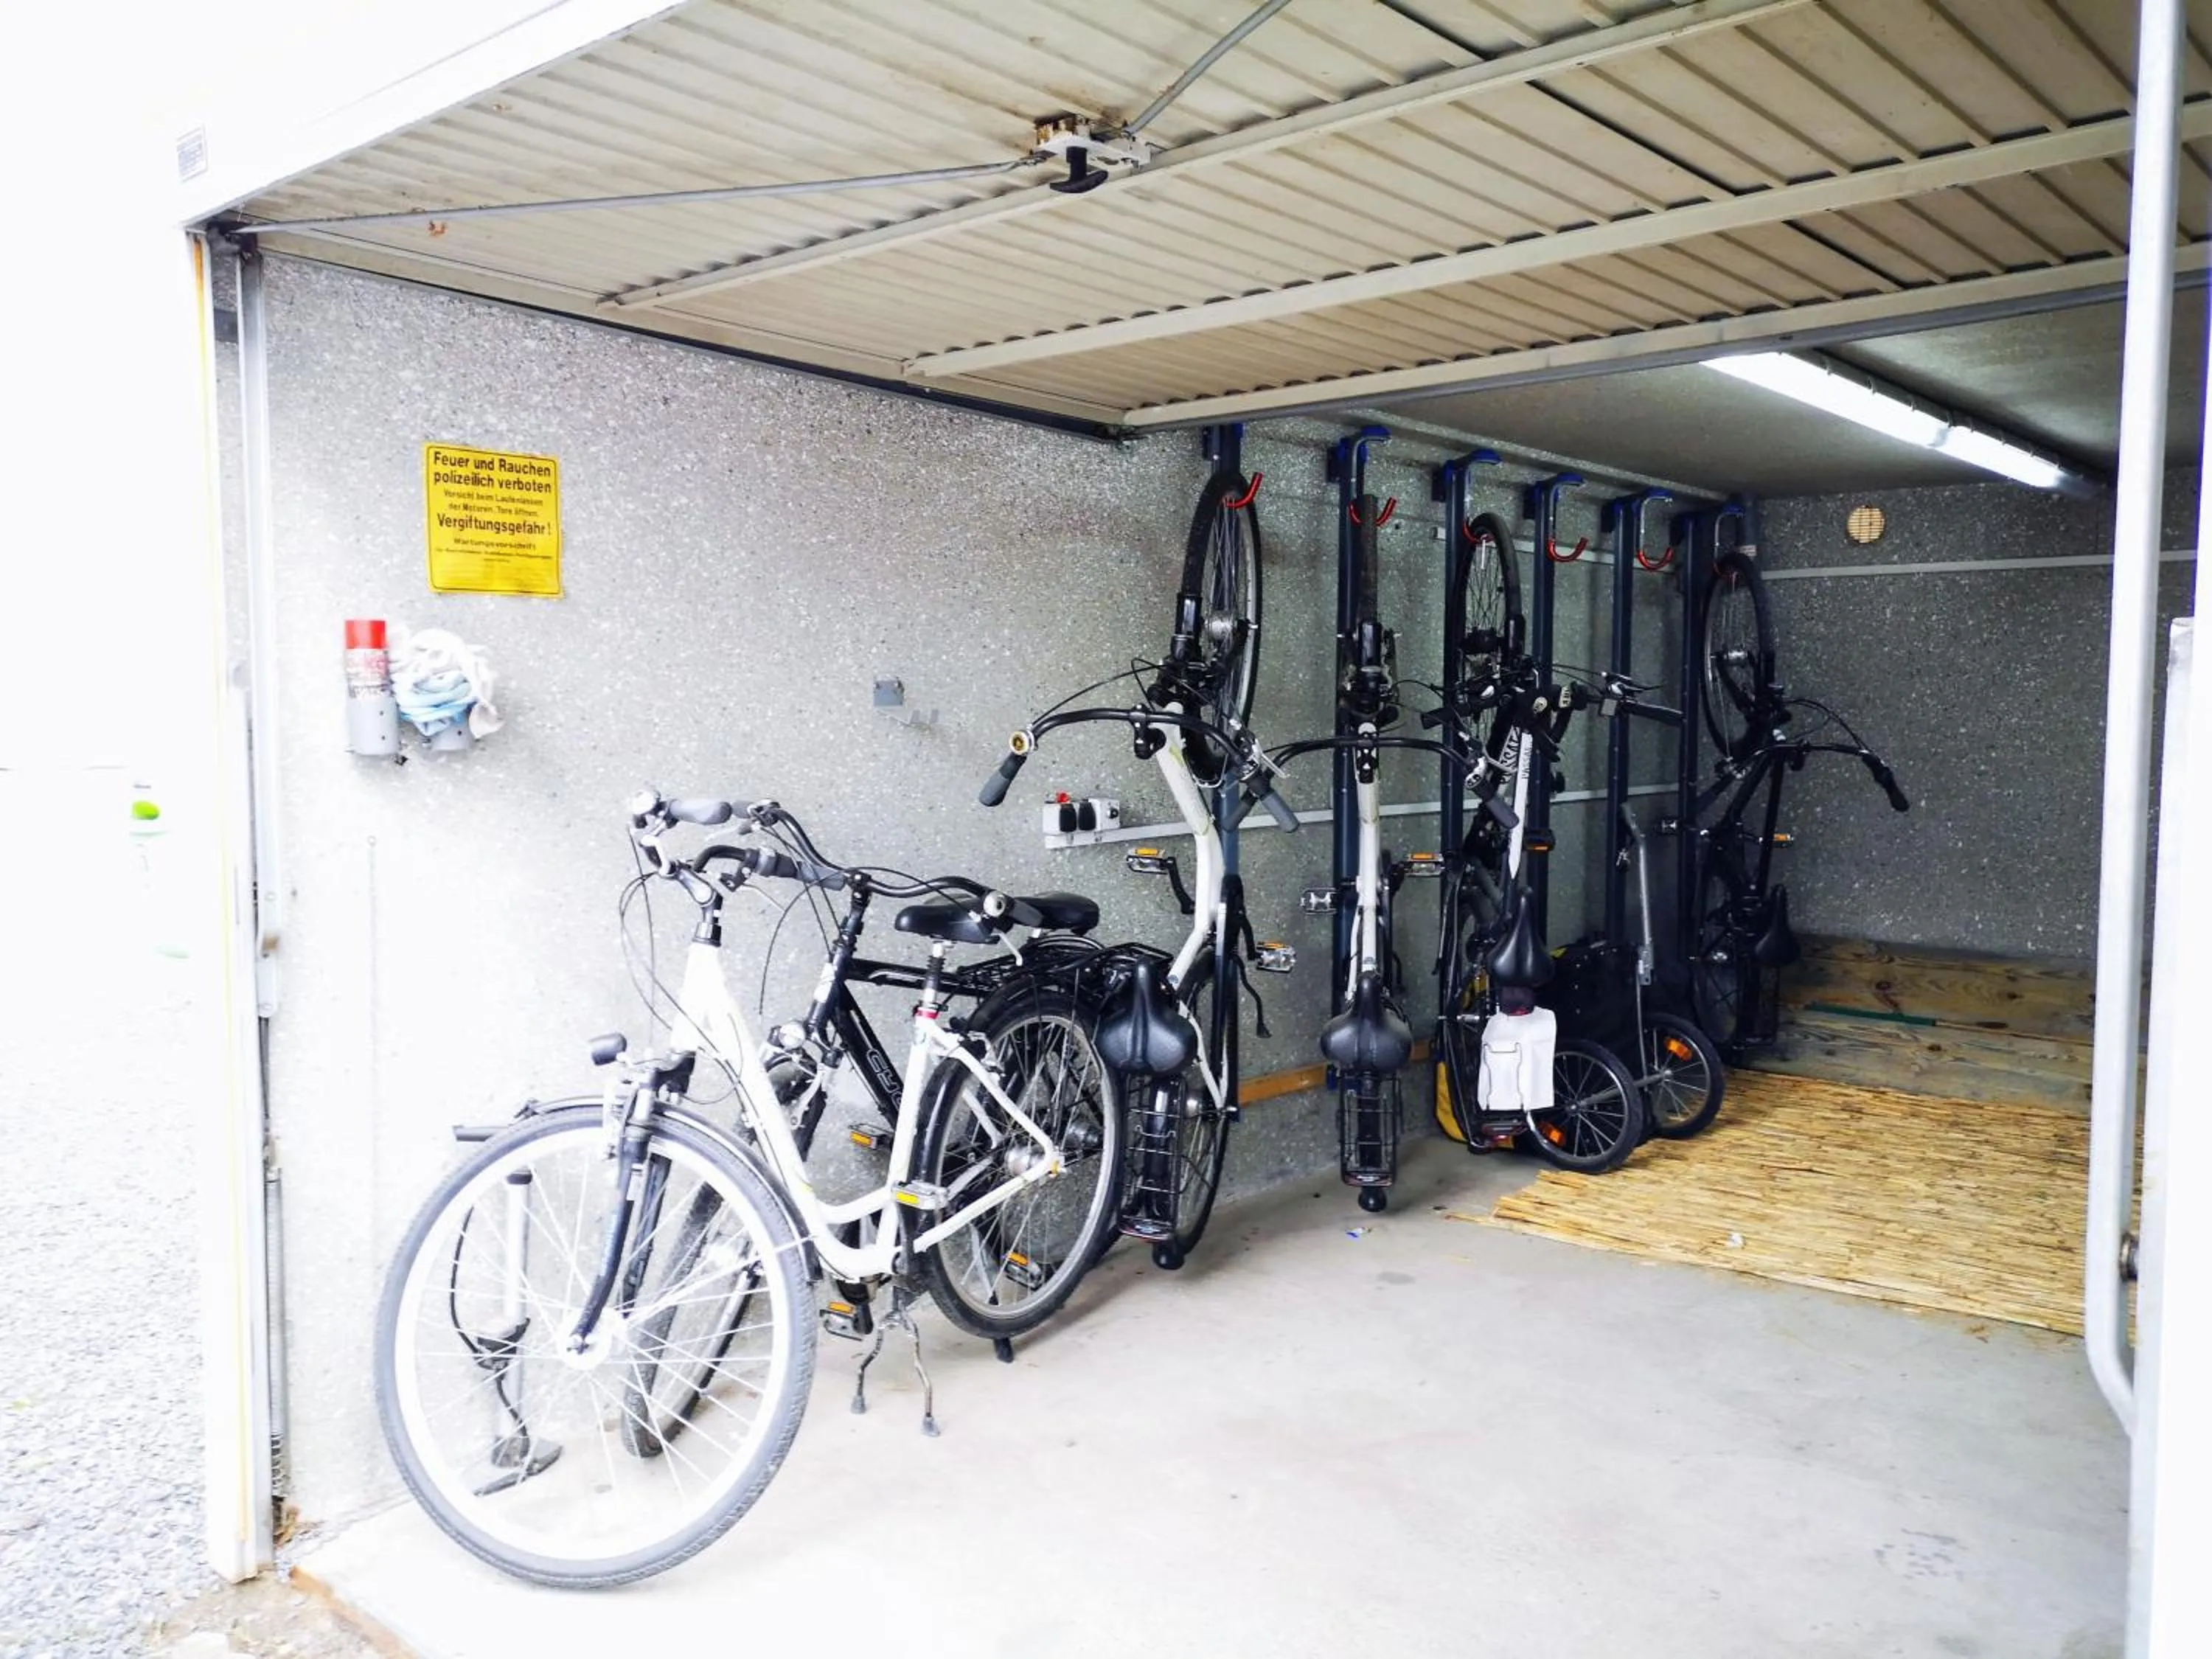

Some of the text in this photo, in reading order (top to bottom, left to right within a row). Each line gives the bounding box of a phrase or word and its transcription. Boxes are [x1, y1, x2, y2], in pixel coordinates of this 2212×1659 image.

[434, 451, 551, 477] Feuer und Rauchen
[434, 470, 551, 493] polizeilich verboten
